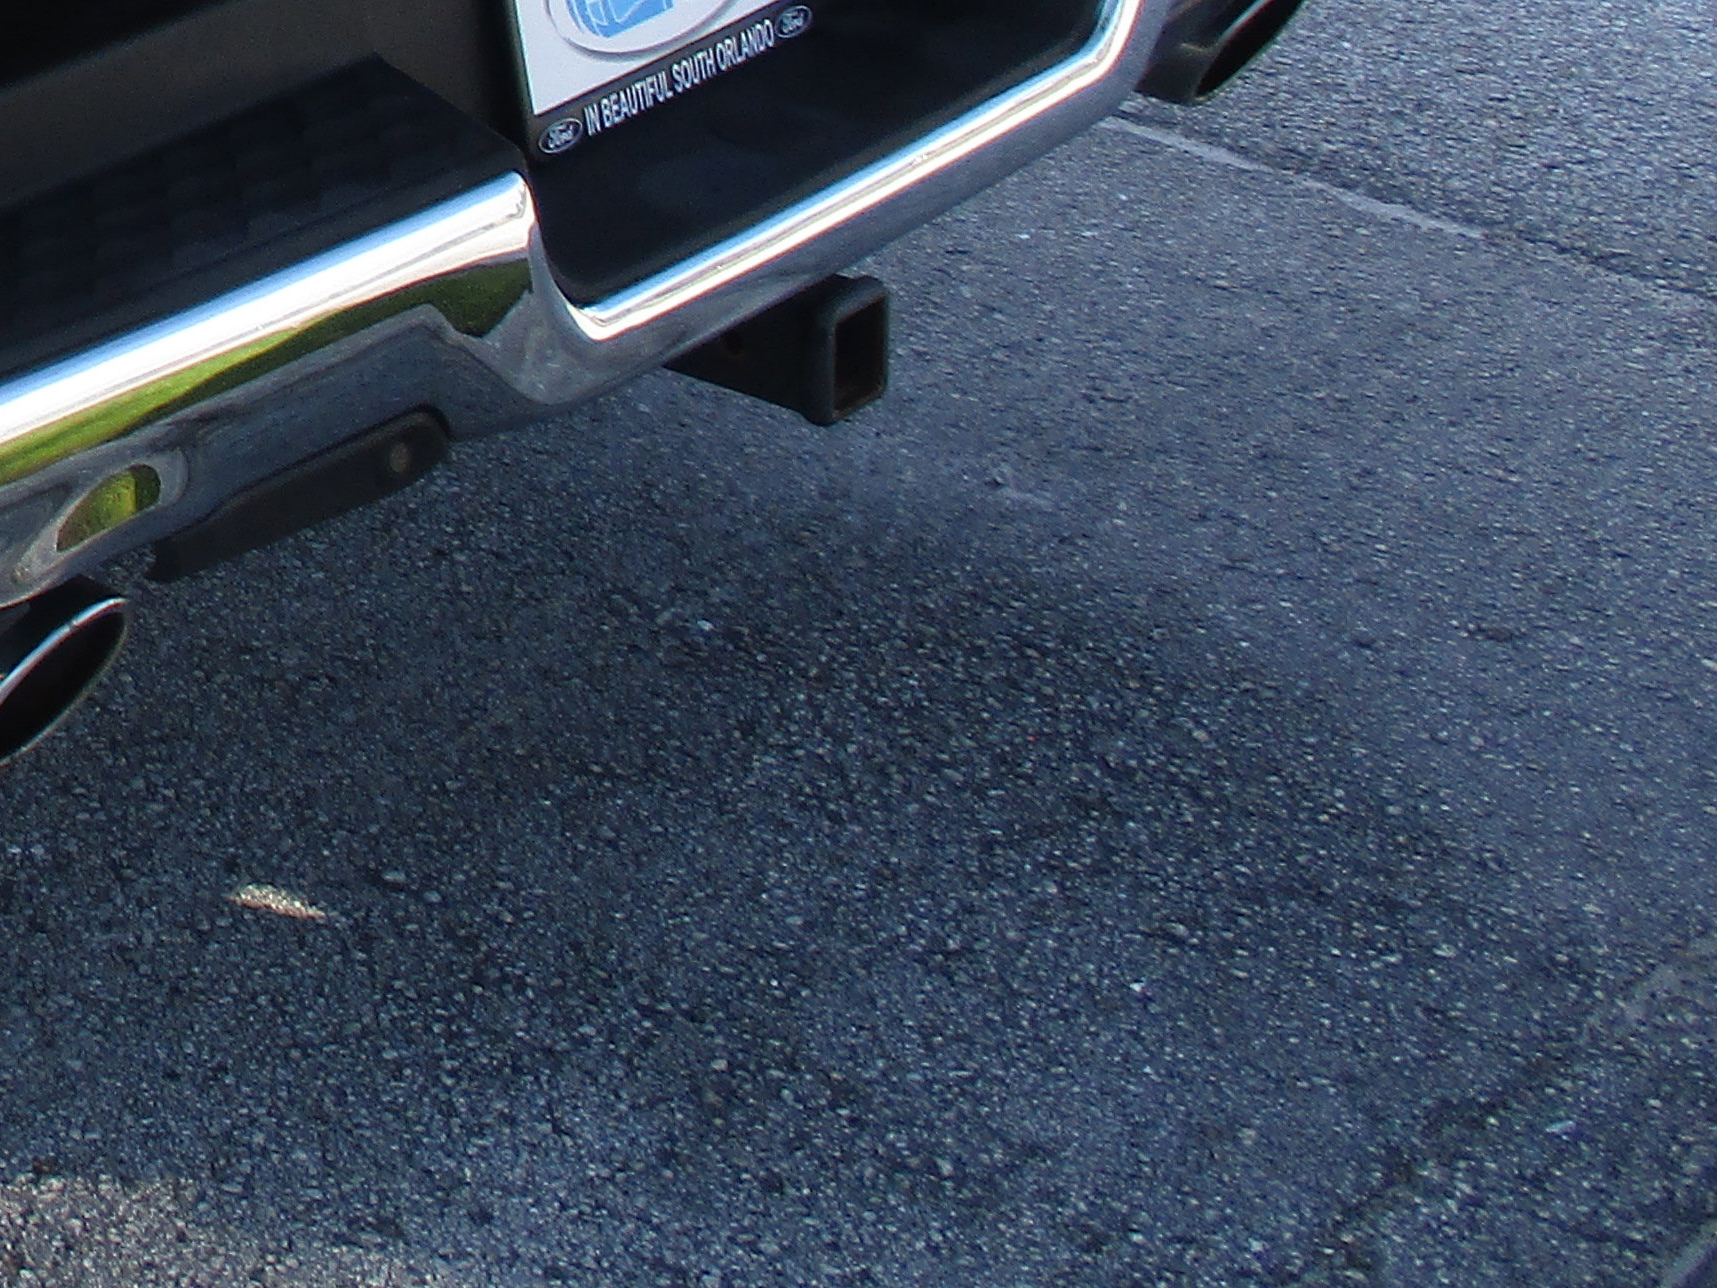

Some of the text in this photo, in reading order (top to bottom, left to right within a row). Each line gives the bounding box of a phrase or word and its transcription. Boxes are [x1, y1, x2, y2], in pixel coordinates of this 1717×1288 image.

[582, 19, 775, 136] IN BEAUTIFUL SOUTH ORLANDO
